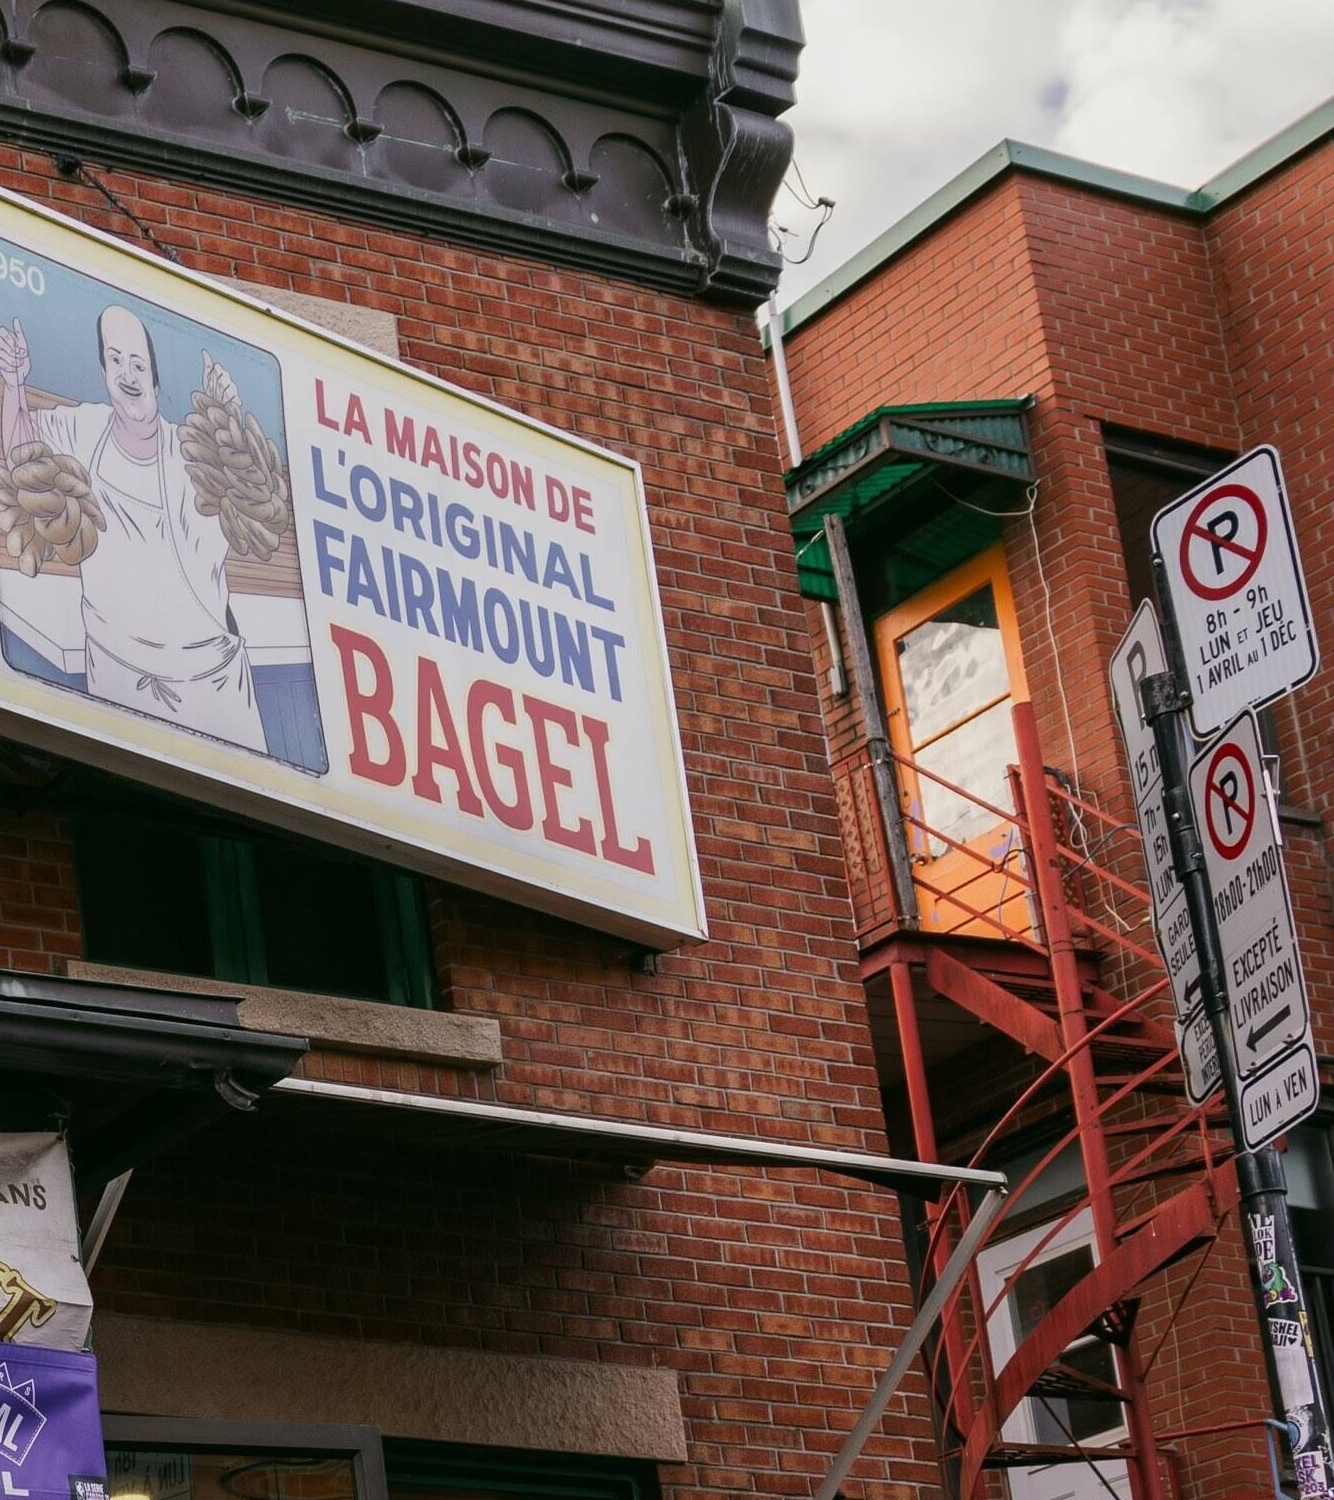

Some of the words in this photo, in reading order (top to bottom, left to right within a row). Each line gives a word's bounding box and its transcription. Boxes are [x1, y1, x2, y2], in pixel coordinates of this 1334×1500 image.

[314, 378, 372, 446] LA
[385, 408, 535, 512] MAISON
[544, 475, 596, 535] DE
[310, 446, 615, 611] L'ORIGINAL
[312, 517, 624, 701] FAIRMOUNT
[1200, 631, 1231, 665] LUN
[1237, 628, 1247, 644] ET
[1256, 599, 1283, 633] JEU
[1206, 609, 1227, 633] 8h
[1247, 585, 1268, 609] 9h
[1197, 674, 1203, 694] 1
[1209, 652, 1244, 688] AVRIL
[1248, 649, 1259, 666] AU
[1261, 637, 1267, 656] 1
[1270, 620, 1296, 650] DÉC
[330, 622, 655, 876] BAGEL
[1168, 908, 1190, 946] GARD
[1171, 934, 1196, 977] SEULE
[1233, 917, 1282, 988] EXCEPTÉ
[1234, 958, 1294, 1029] LIVRAISON
[1250, 1092, 1271, 1126] LUN
[1283, 1066, 1307, 1102] VEN
